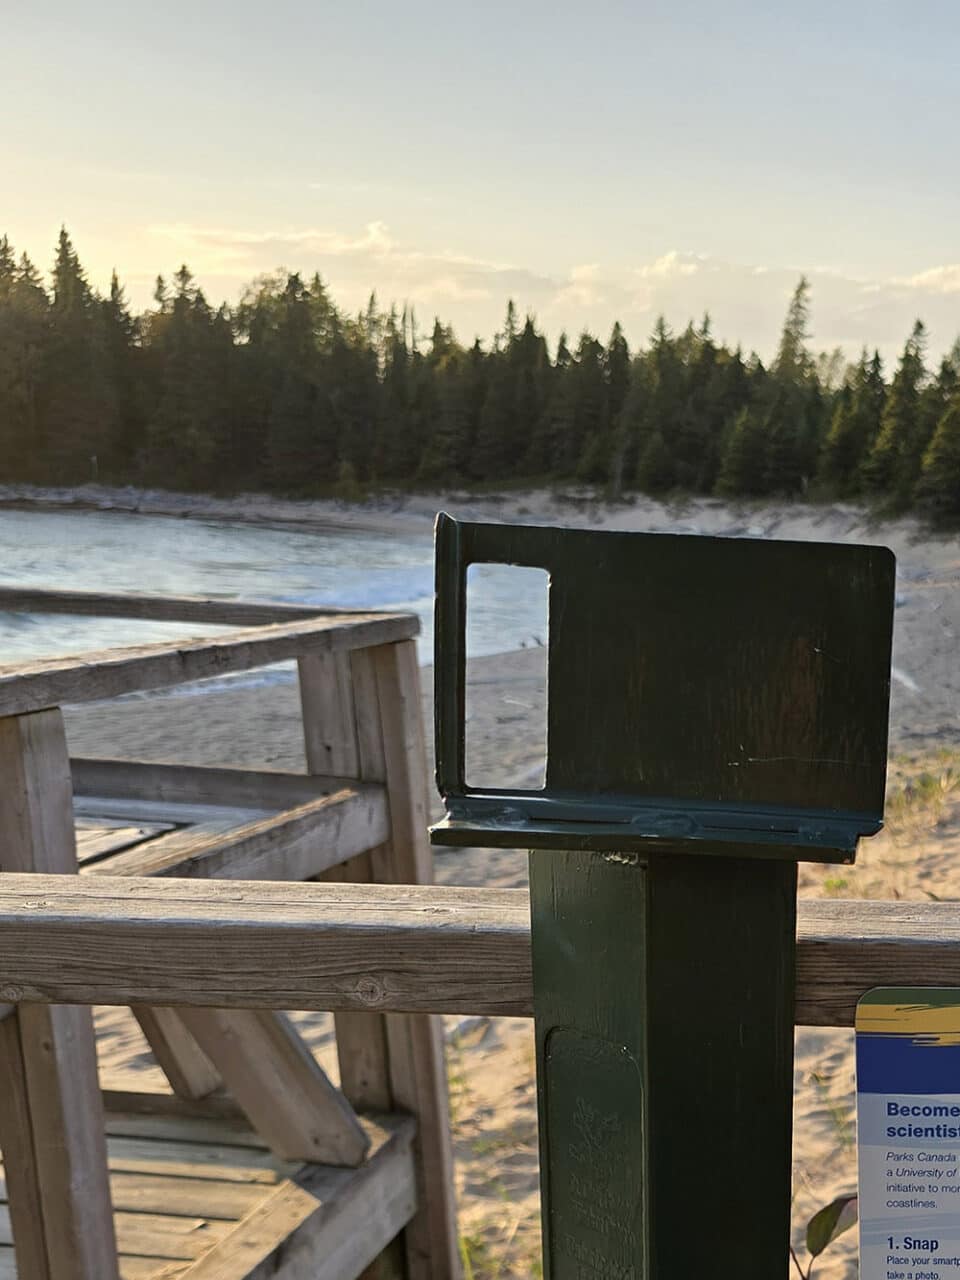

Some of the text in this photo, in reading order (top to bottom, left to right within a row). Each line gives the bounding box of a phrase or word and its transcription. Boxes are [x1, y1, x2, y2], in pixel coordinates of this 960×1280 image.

[887, 1102, 960, 1116] Become
[886, 1151, 913, 1161] Parks
[917, 1152, 956, 1161] Canada
[896, 1167, 944, 1178] University
[946, 1167, 958, 1176] of
[886, 1183, 925, 1192] initiative
[928, 1184, 938, 1192] to
[886, 1198, 937, 1207] coastlines.
[887, 1236, 938, 1253] 1. Snap
[886, 1255, 909, 1264] Place
[910, 1257, 929, 1266] your
[887, 1269, 904, 1279] take
[914, 1270, 941, 1280] photo.
